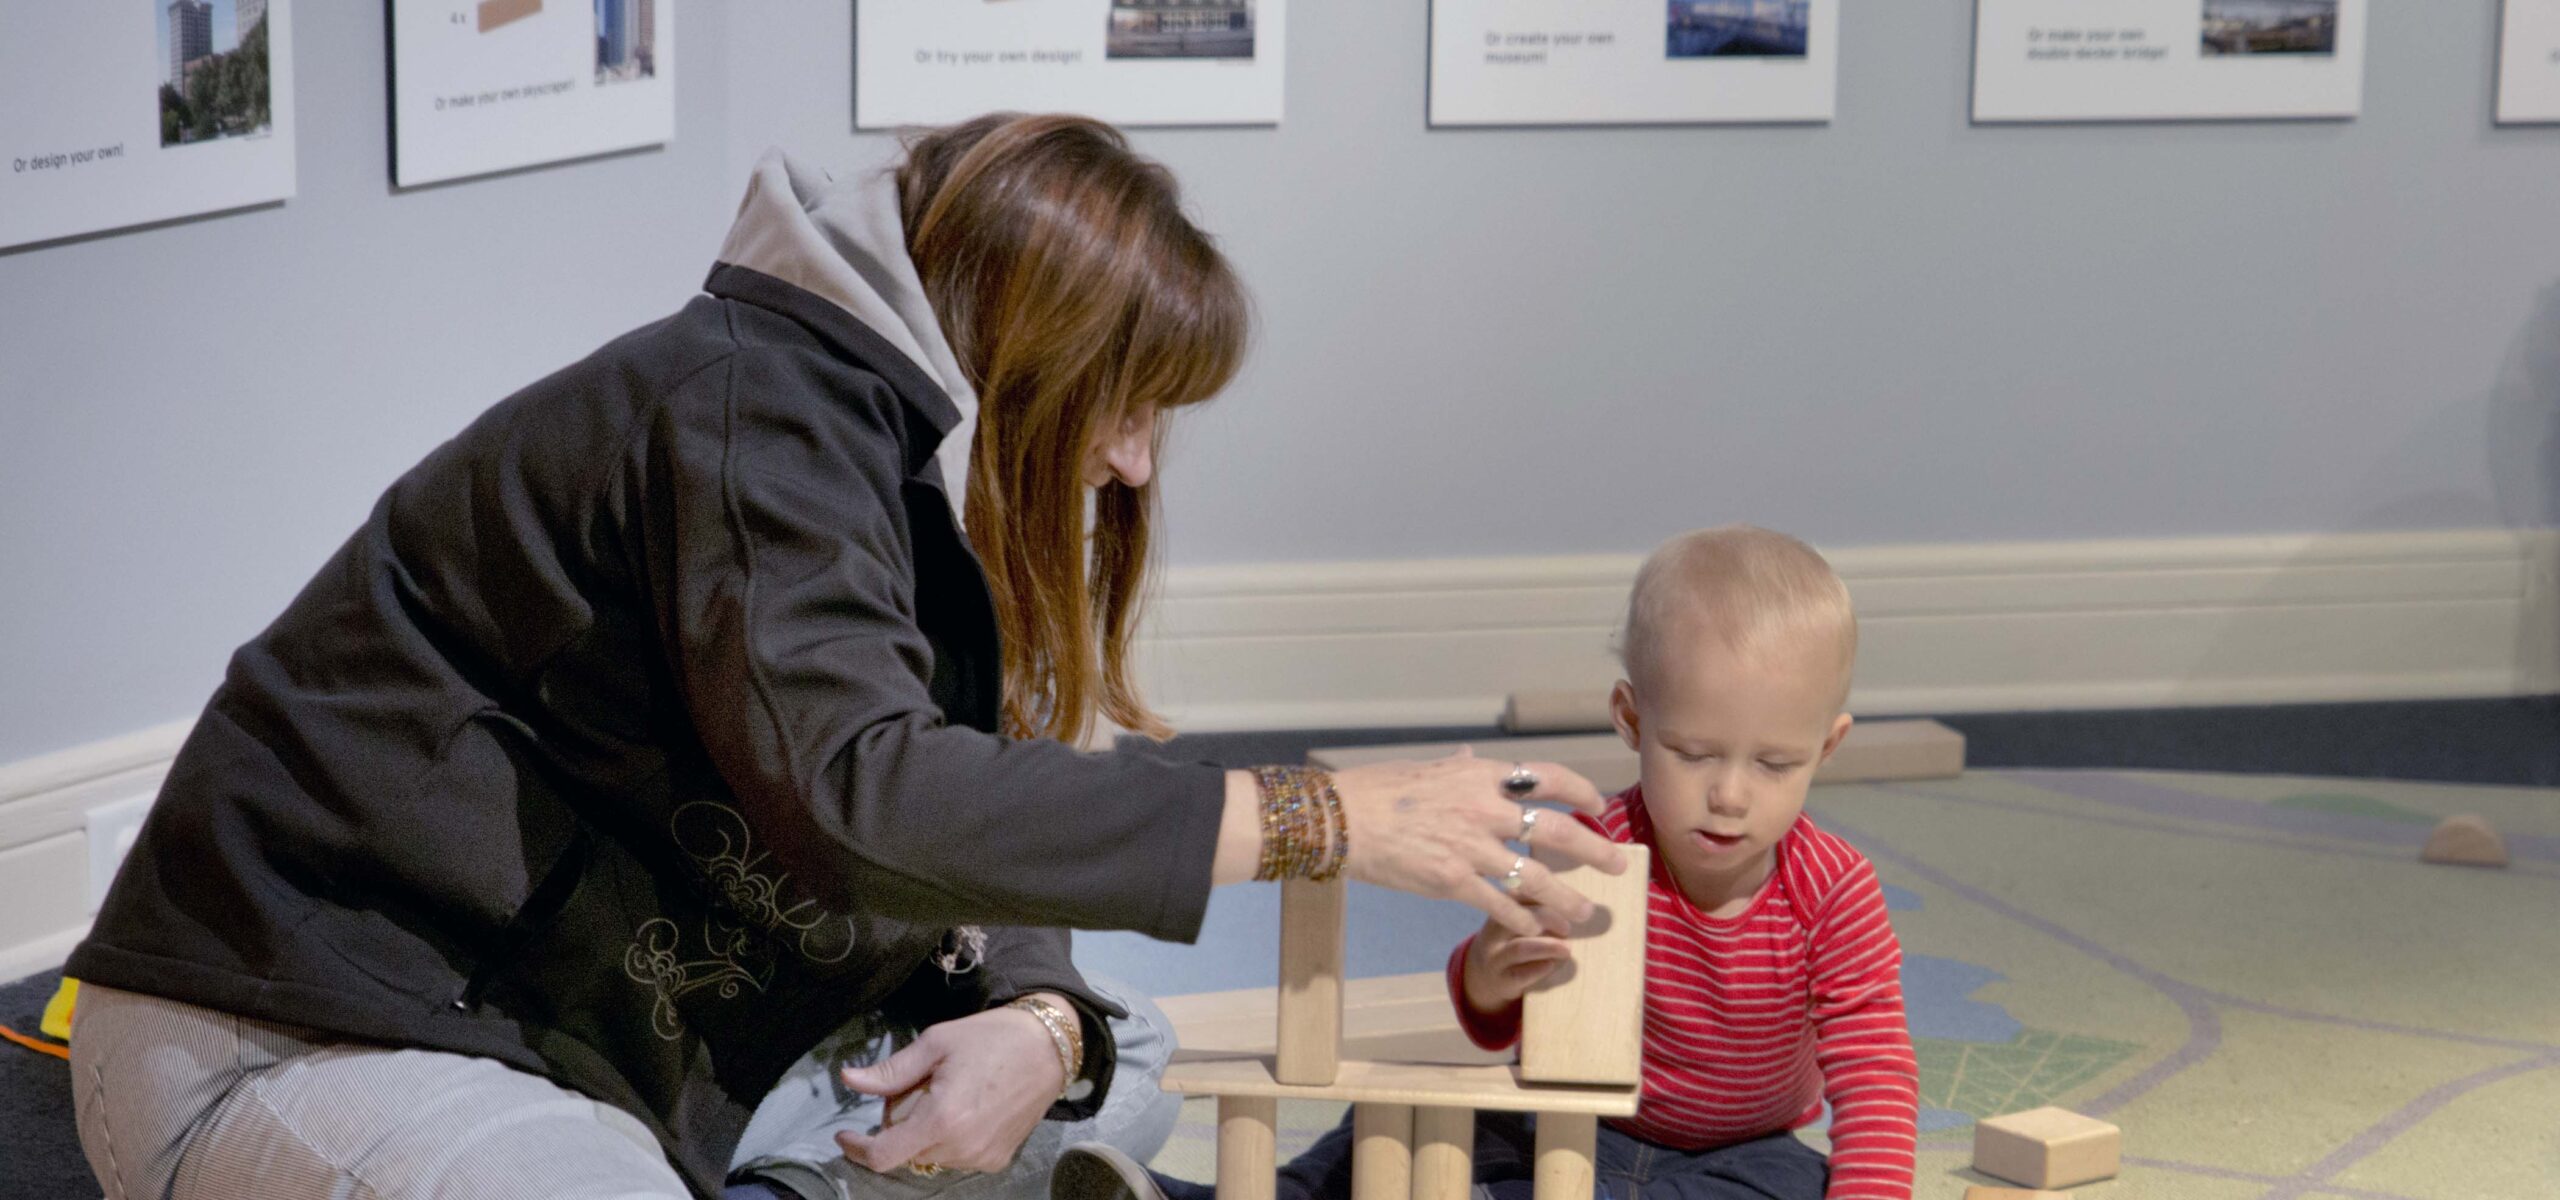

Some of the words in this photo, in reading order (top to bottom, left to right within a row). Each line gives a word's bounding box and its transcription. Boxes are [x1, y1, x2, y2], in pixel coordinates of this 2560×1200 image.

[1484, 31, 1501, 47] Or
[1552, 33, 1582, 48] your
[1587, 33, 1615, 46] own
[914, 48, 931, 63] Or
[936, 48, 959, 66] try
[963, 49, 993, 66] your
[998, 50, 1028, 63] own
[1032, 47, 1082, 66] design!
[434, 97, 446, 112] Or
[449, 94, 475, 108] make
[478, 92, 498, 107] your
[501, 89, 520, 102] own
[14, 157, 27, 173] Or
[30, 151, 67, 170] design
[70, 148, 95, 169] your
[98, 142, 124, 160] own!
